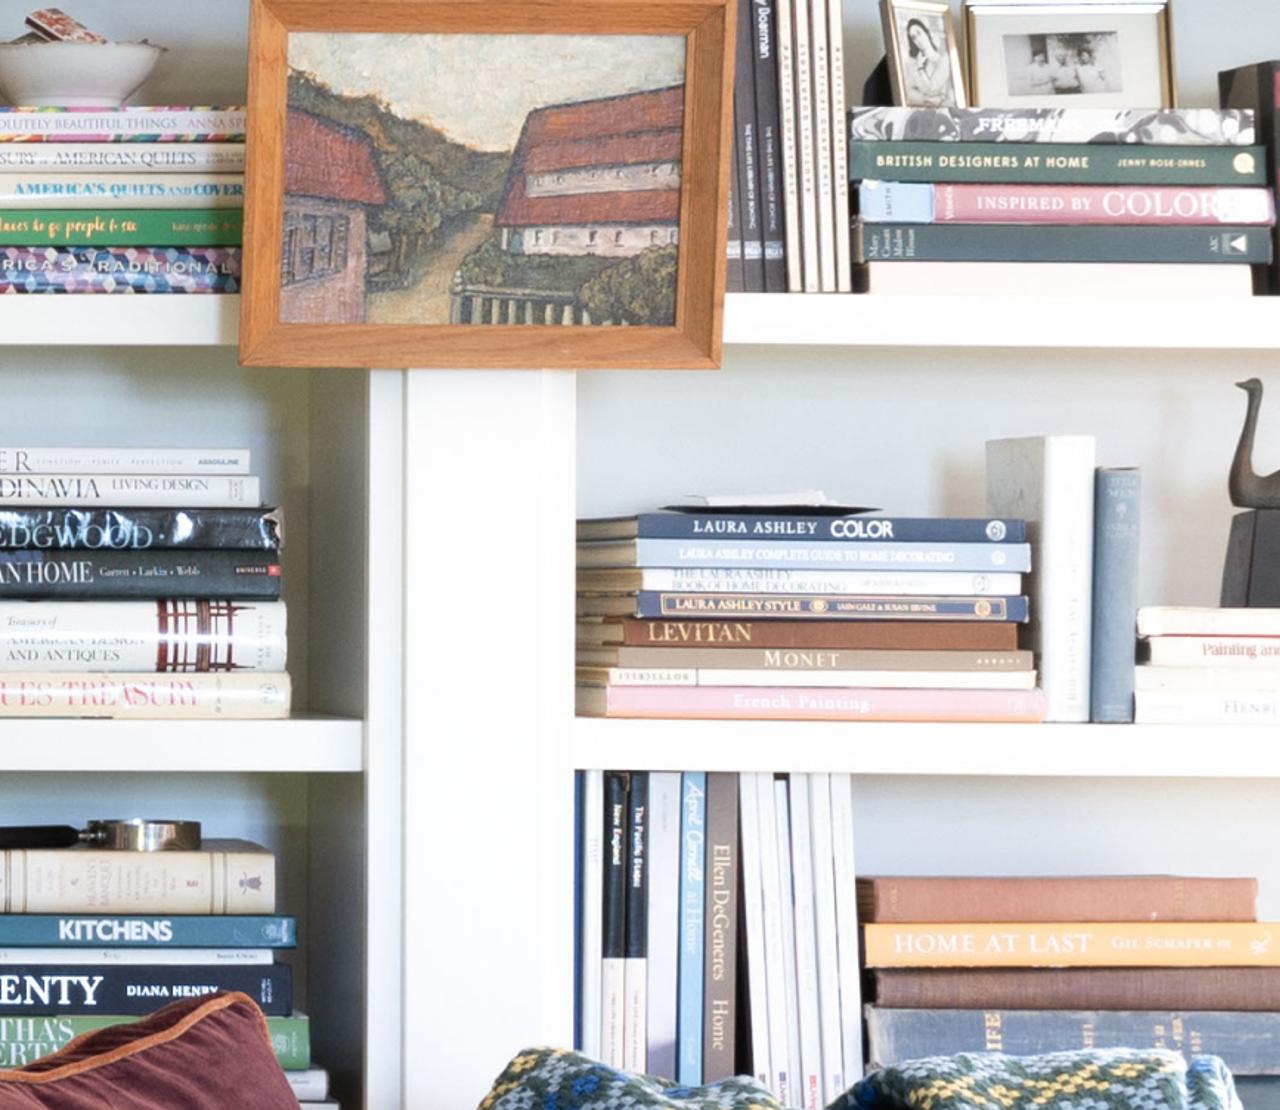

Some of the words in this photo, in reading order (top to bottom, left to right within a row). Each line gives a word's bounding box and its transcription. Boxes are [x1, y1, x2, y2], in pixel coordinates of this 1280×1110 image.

[55, 118, 121, 129] BEAUTIFUL
[127, 118, 177, 129] THINGS
[188, 118, 227, 129] ANNA
[53, 152, 136, 165] AMERICAN
[141, 152, 197, 166] QUILTS
[876, 155, 933, 168] BRITISH
[939, 155, 1018, 168] DESIGNERS
[1024, 156, 1040, 168] AT
[1046, 156, 1089, 169] HOME
[14, 183, 105, 196] AMERICA'S
[109, 183, 165, 197] QUILTS
[977, 196, 1065, 211] INSPIRED
[1071, 197, 1091, 211] BY
[1102, 191, 1219, 218] COLOR
[66, 217, 105, 238] people
[81, 249, 232, 274] TRADITIONAL
[112, 479, 159, 491] LIVING
[161, 480, 209, 492] DESIGN
[693, 520, 748, 535] LAURA
[753, 520, 817, 535] ASHLEY
[830, 520, 894, 539] COLOR
[679, 549, 714, 561] LAURA
[715, 549, 753, 561] ASHLEY
[756, 550, 808, 562] COMPLETE
[810, 550, 841, 562] GUIDE
[843, 550, 857, 562] TO
[859, 550, 887, 562] HOME
[890, 551, 955, 563] DECORATING
[26, 562, 95, 584] HOME
[99, 566, 130, 577] Garrett
[139, 566, 169, 577] Larkin
[176, 566, 201, 577] Webb
[672, 569, 694, 580] THE
[698, 569, 739, 580] LAURA
[742, 569, 793, 581] ASHLEY
[672, 581, 703, 592] BOOK
[704, 581, 721, 592] OF
[726, 582, 762, 593] HOME
[766, 582, 847, 594] DECORATING
[676, 599, 715, 611] LAURA
[717, 599, 763, 612] ASHLEY
[764, 599, 800, 612] STYLE
[649, 622, 753, 643] LEVITAN
[6, 649, 41, 662] AND
[45, 649, 121, 664] ANTIQUES
[764, 650, 840, 668] MONET
[1202, 643, 1258, 660] Painting
[62, 682, 200, 708] TREASURY
[733, 694, 791, 711] French
[798, 694, 870, 714] Painting
[686, 781, 704, 826] April
[711, 845, 731, 887] Ellen
[58, 919, 173, 943] KITCHENS
[687, 907, 702, 956] Home
[711, 889, 731, 981] DeGeneres
[895, 933, 975, 954] HOME
[983, 933, 1020, 954] AT
[1029, 933, 1093, 954] LAST
[1112, 937, 1140, 950] GIL
[1145, 936, 1214, 950] SCHAFER
[127, 985, 169, 998] DIANA
[711, 998, 729, 1051] Home
